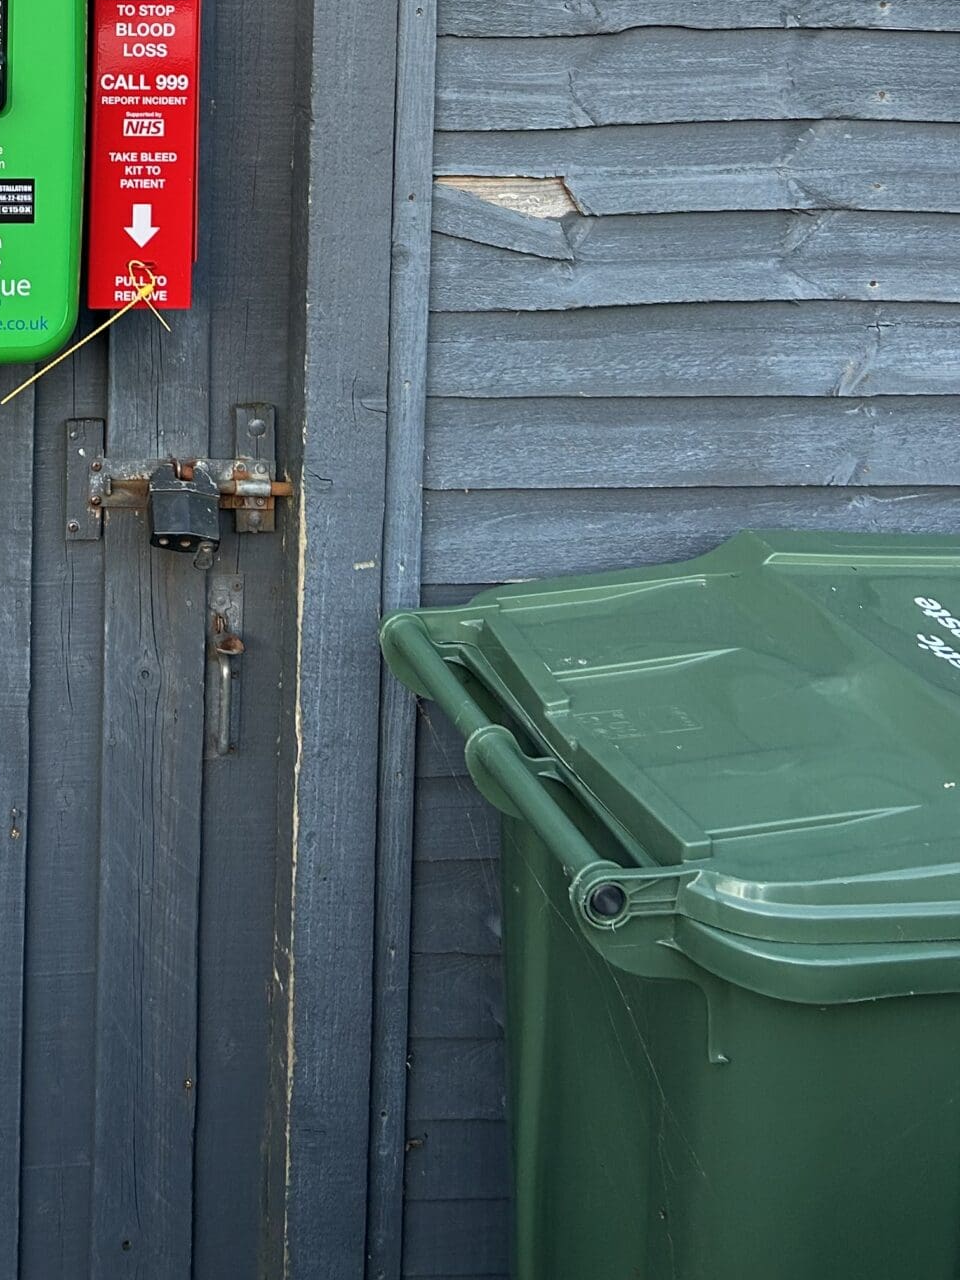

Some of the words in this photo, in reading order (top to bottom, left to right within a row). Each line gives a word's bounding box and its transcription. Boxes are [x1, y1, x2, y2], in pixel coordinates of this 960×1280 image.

[117, 5, 135, 16] TO
[139, 5, 175, 17] STOP
[116, 23, 175, 37] BLOOD
[123, 43, 168, 57] LOSS
[100, 74, 151, 90] CALL
[155, 75, 189, 90] 999
[101, 96, 139, 105] REPORT
[142, 96, 188, 105] INCIDENT
[125, 121, 162, 134] NHS
[109, 152, 138, 162] TAKE
[141, 152, 177, 162] BLEED
[125, 166, 143, 175] KIT
[146, 166, 161, 175] TO
[120, 179, 166, 189] PATIENT
